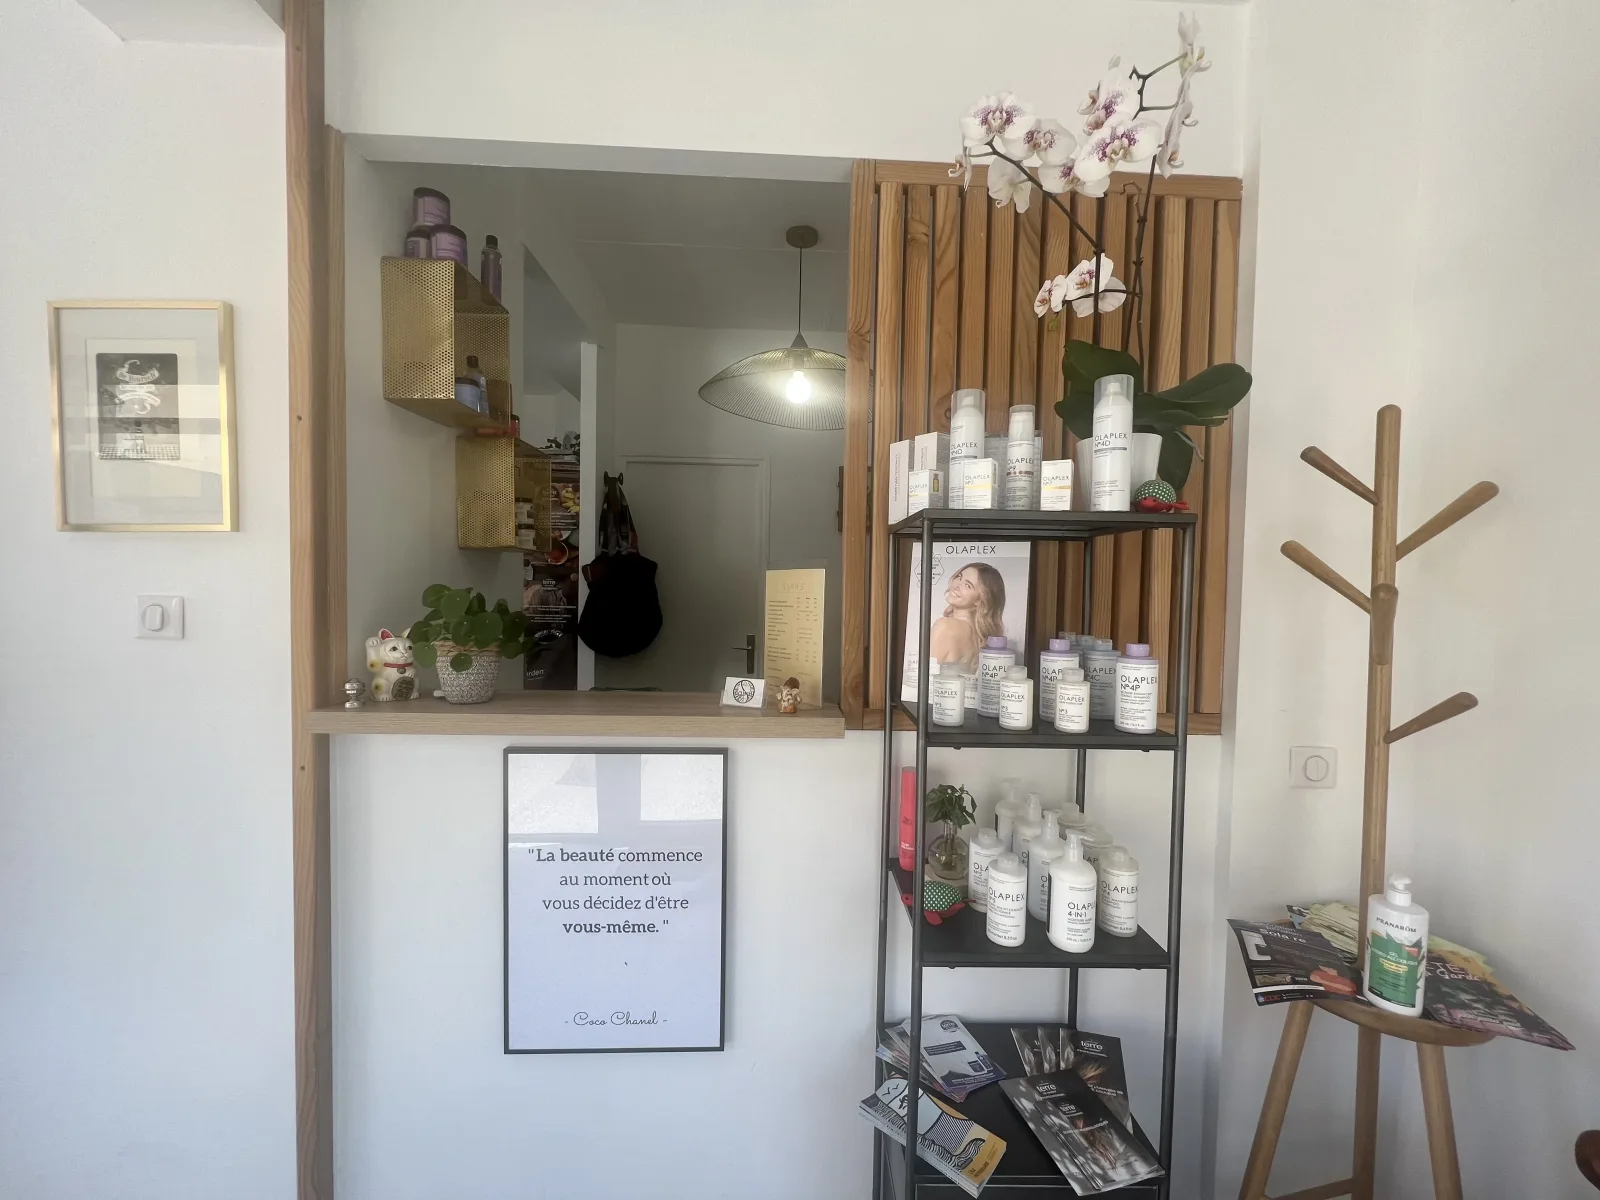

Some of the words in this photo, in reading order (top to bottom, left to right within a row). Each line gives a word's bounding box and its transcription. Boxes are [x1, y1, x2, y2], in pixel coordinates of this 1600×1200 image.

[1094, 432, 1128, 442] OLAPLEX
[945, 545, 997, 554] OLAPLEX
[981, 663, 1007, 673] OLAPL
[1041, 666, 1063, 676] OLAP
[934, 688, 958, 696] OLAPLEX
[1000, 692, 1026, 700] OLAPLEX
[1058, 694, 1086, 703] OLAPLEX
[560, 848, 615, 863] beauté
[618, 850, 703, 863] commence
[559, 874, 579, 886] au
[583, 873, 649, 886] moment
[651, 872, 671, 886] où
[988, 886, 1025, 902] OLAPLEX
[542, 897, 580, 910] vous
[583, 896, 642, 910] décidez
[645, 896, 689, 910] d'être
[573, 1011, 607, 1027] Coco
[610, 1011, 659, 1027] Chanel
